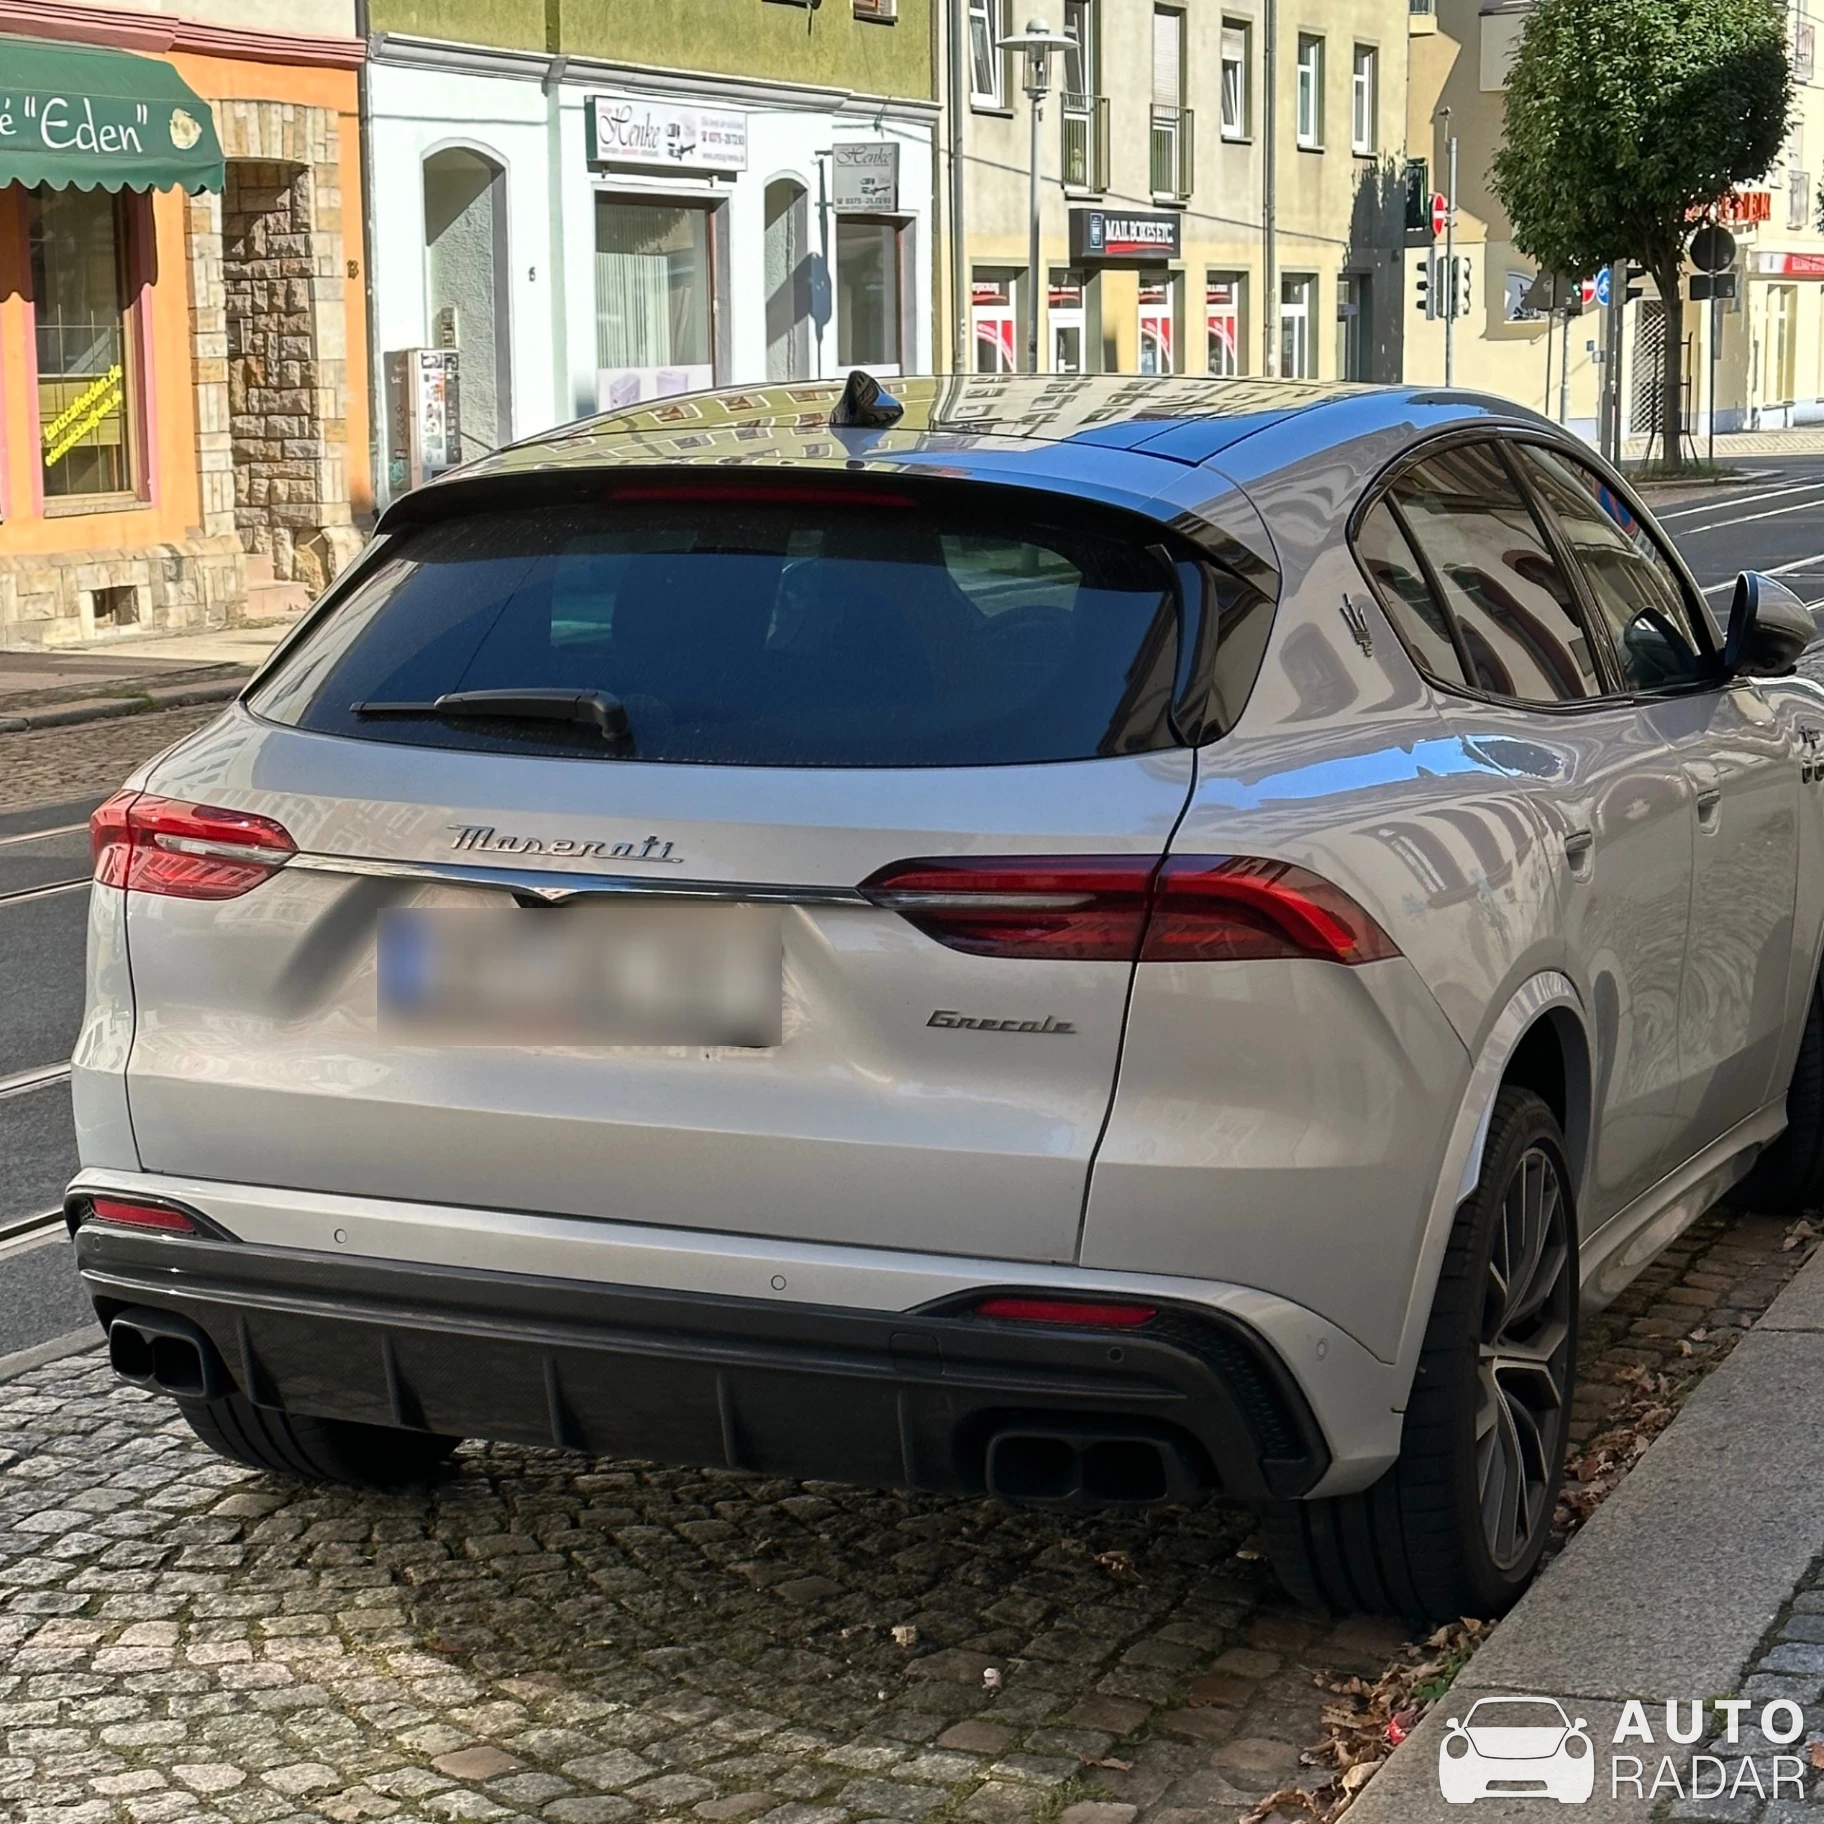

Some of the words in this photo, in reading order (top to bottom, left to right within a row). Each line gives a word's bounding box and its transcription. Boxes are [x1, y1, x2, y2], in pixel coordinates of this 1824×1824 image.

[24, 95, 148, 154] "Eden"
[599, 104, 661, 149] Henke
[836, 145, 893, 165] Henke
[1105, 219, 1130, 241] MAIL
[1129, 221, 1156, 243] BOXES
[44, 364, 122, 441] tanzcafeeden.de
[447, 824, 684, 864] Maserati
[926, 1009, 1077, 1034] Grecale
